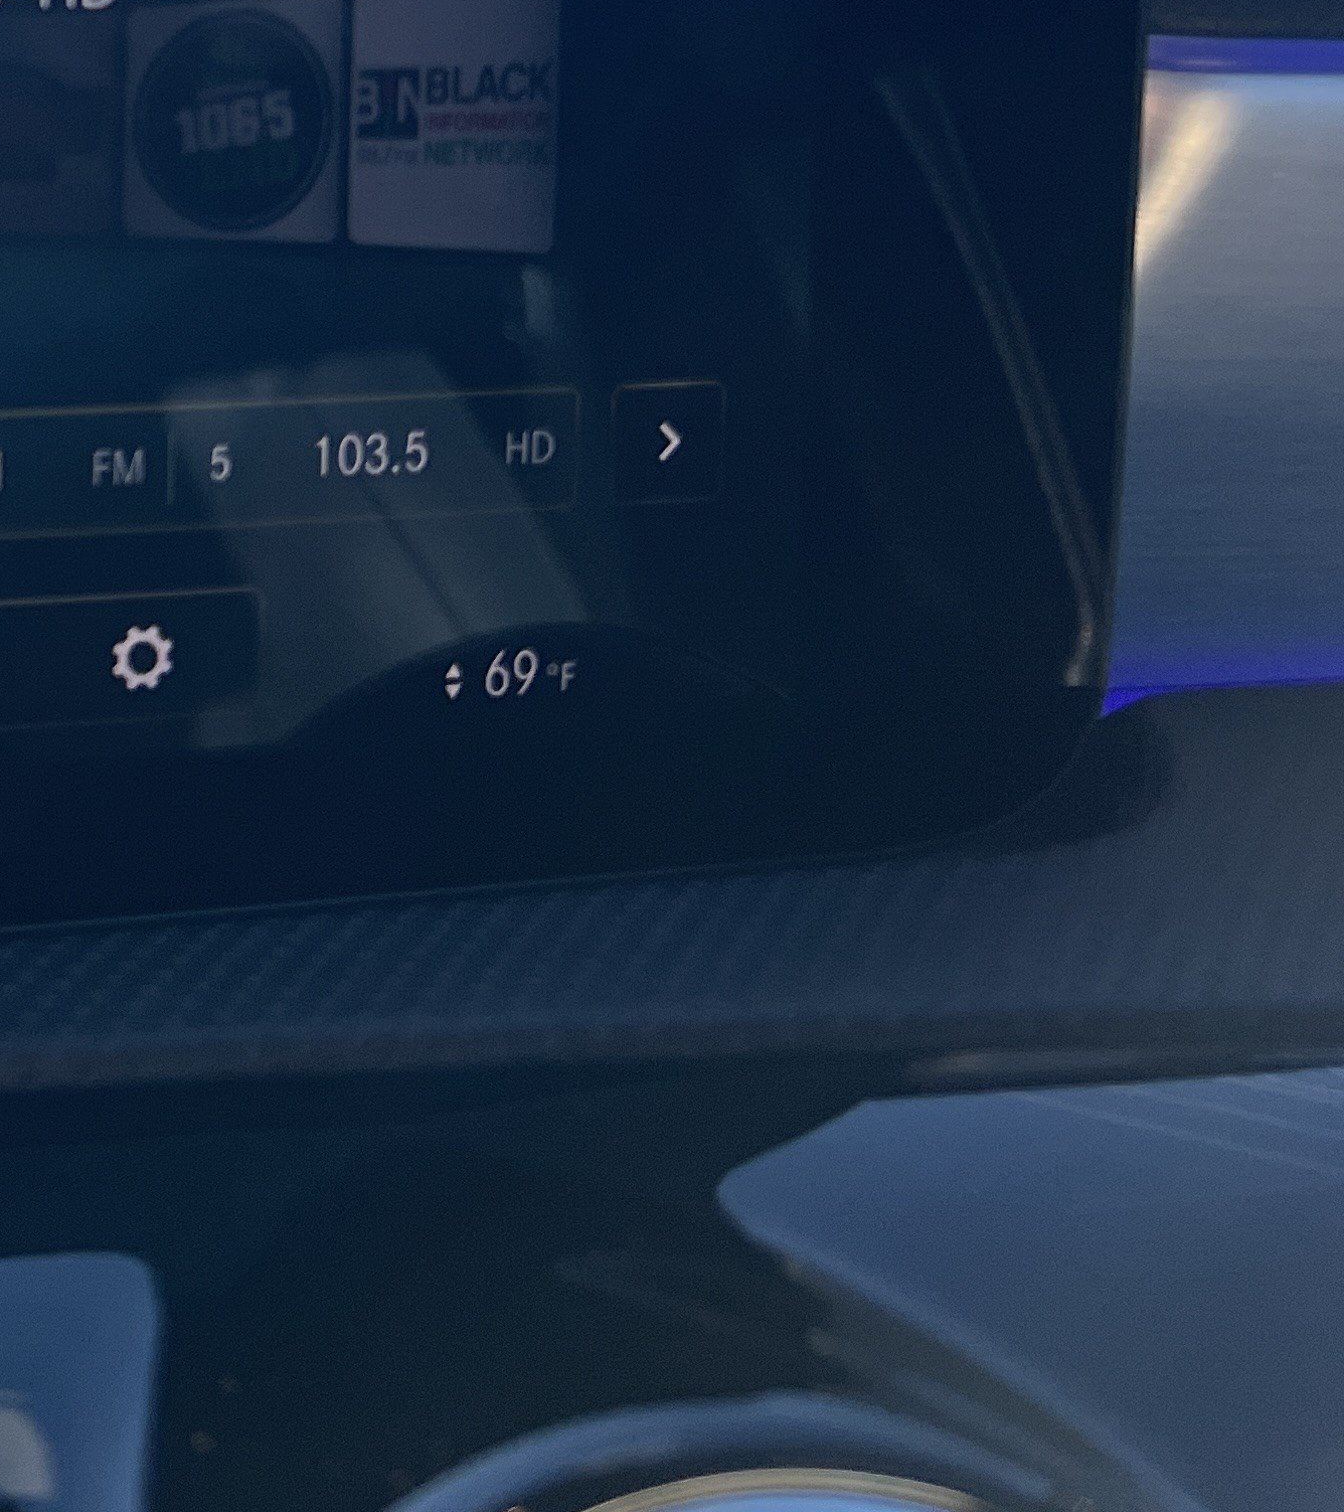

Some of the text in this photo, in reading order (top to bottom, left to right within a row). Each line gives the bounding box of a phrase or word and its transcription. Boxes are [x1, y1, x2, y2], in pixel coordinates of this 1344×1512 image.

[424, 62, 554, 108] BLACK
[92, 448, 146, 487] FM
[211, 428, 556, 483] 5 103.5 HD
[484, 648, 540, 699] 69
